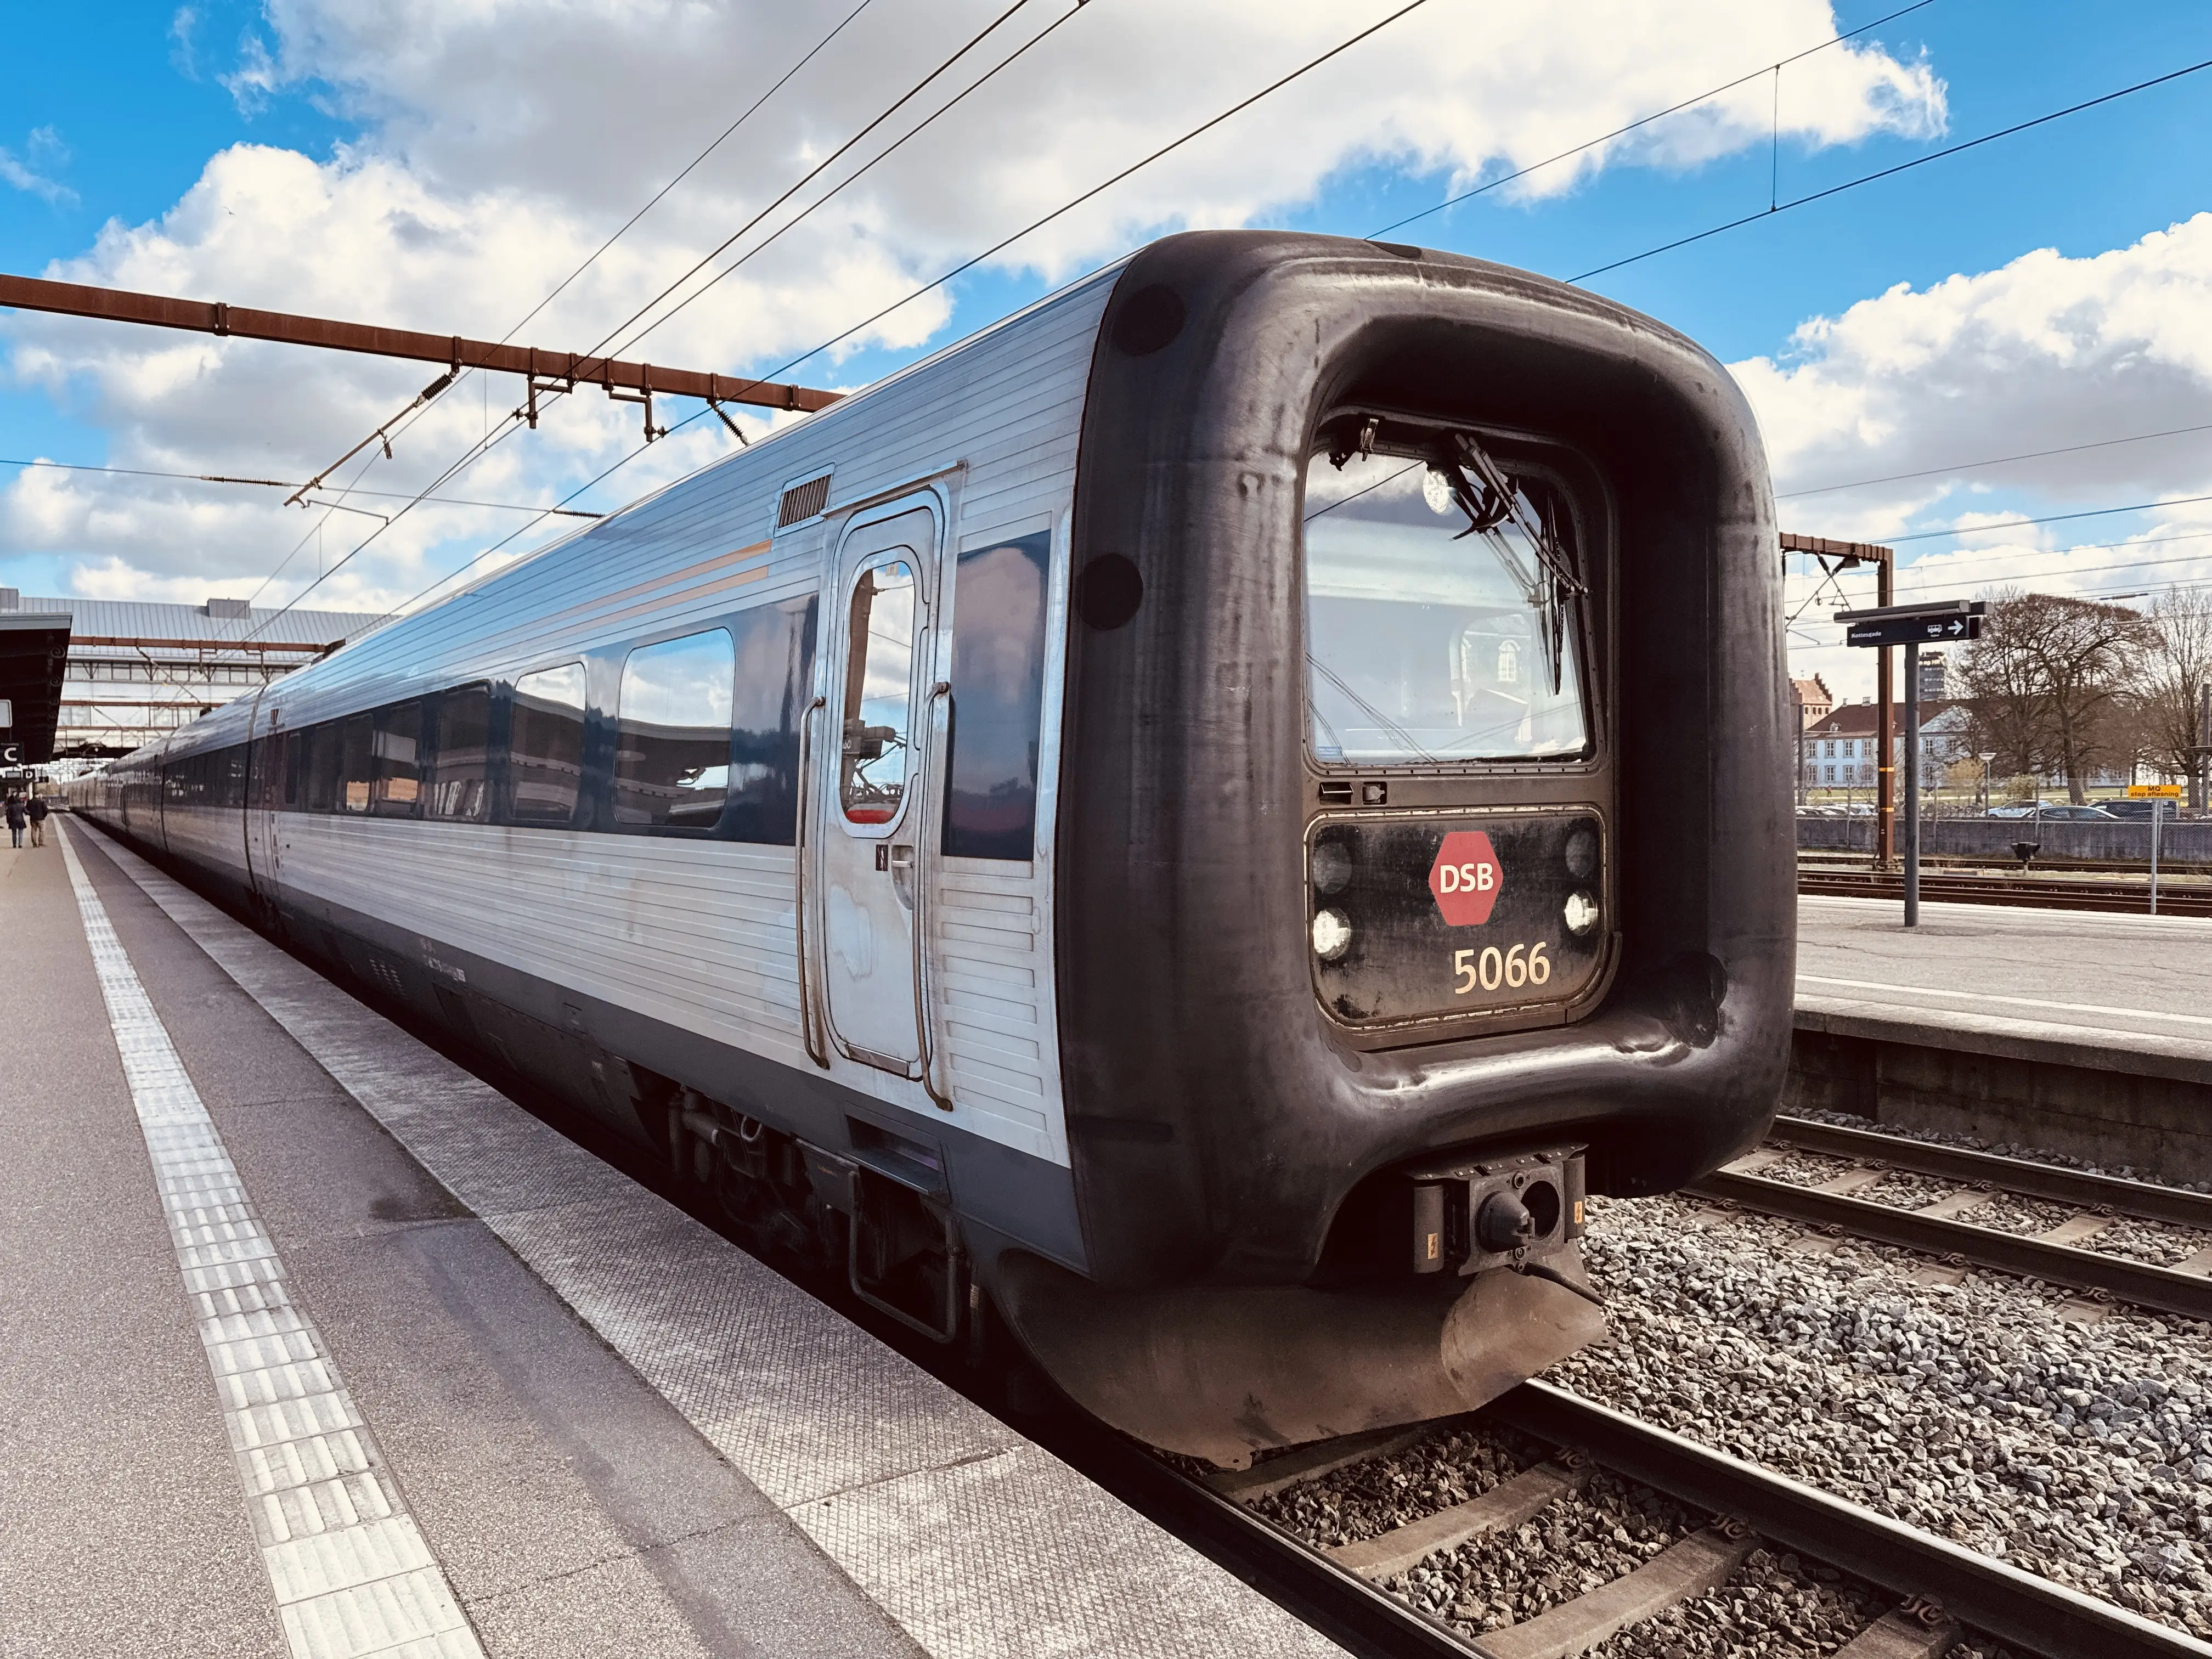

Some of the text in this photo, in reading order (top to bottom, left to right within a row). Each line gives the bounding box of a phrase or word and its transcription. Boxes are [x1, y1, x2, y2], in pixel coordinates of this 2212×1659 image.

[4, 747, 17, 761] C
[26, 771, 33, 779] D
[1440, 862, 1494, 894] DSB
[1454, 941, 1551, 995] 5066
